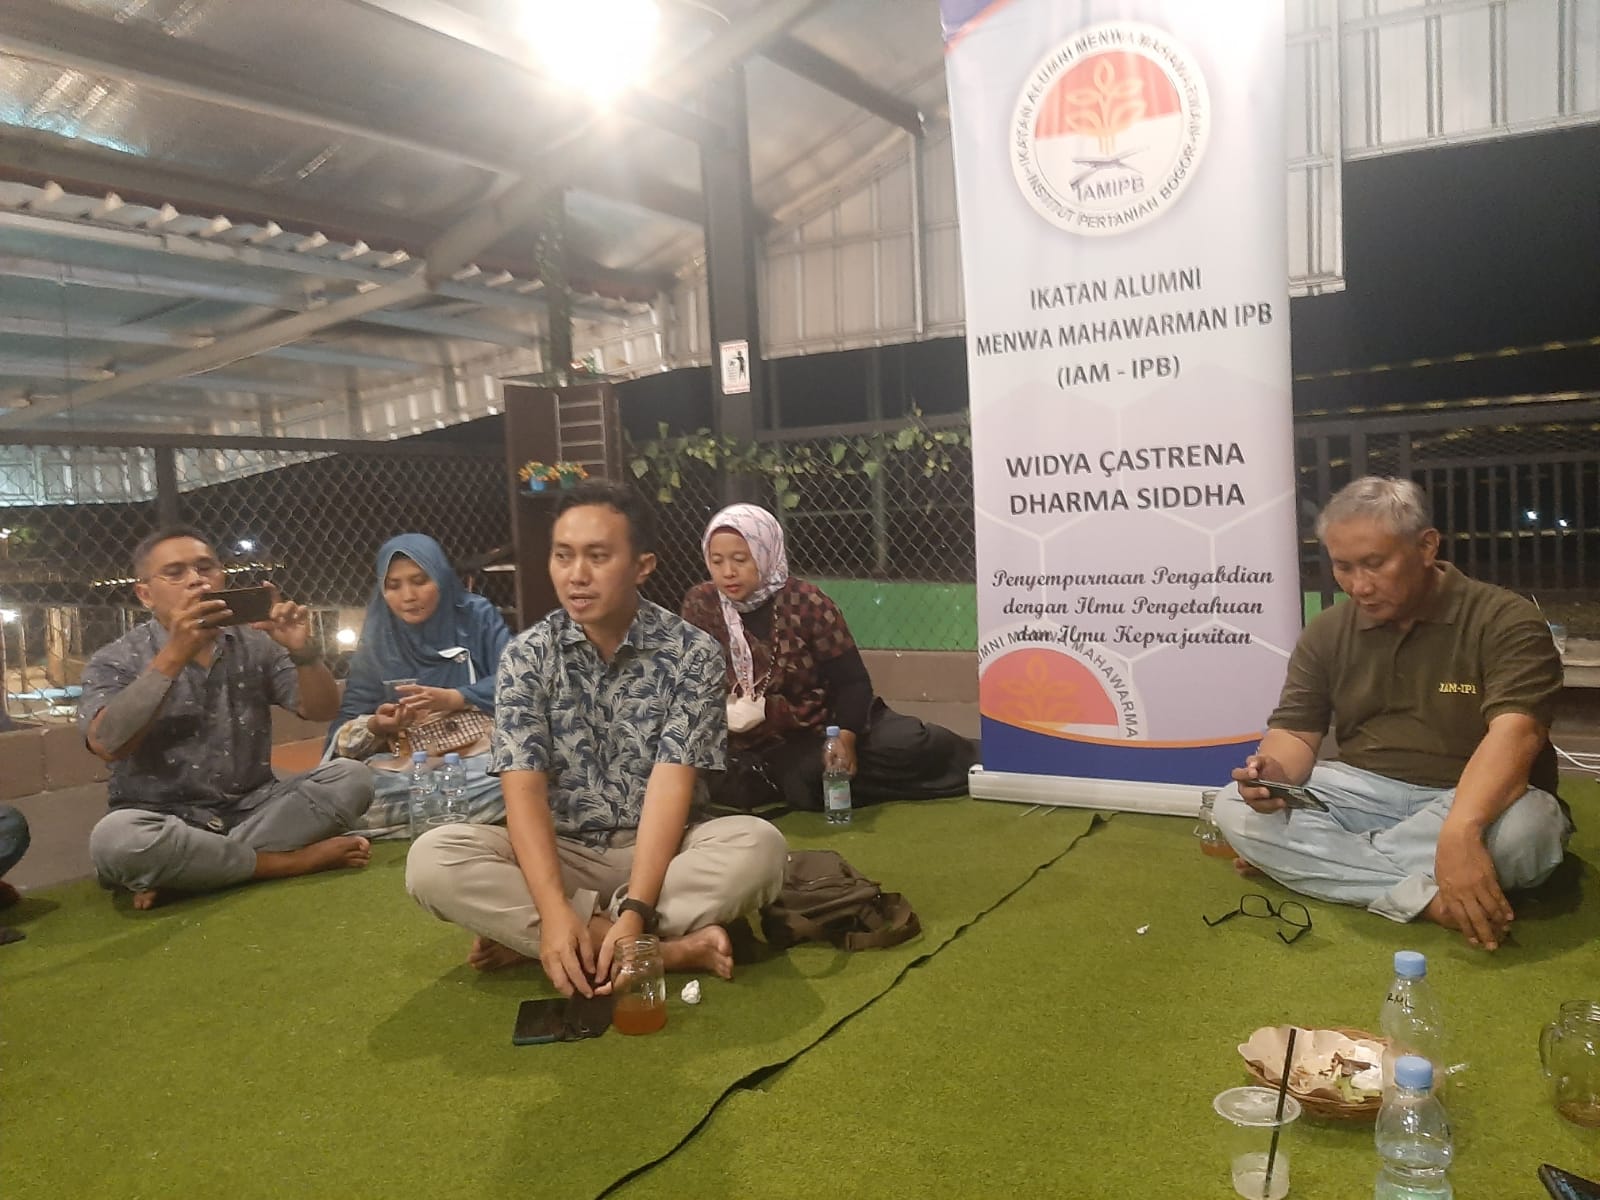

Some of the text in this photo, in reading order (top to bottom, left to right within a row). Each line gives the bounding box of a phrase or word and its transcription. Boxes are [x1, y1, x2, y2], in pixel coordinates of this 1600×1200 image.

[1077, 196, 1160, 229] PERTANIAN
[1030, 266, 1203, 311] IKATAN ALUMNI
[976, 302, 1273, 357] MENWA MAHAWARMAN IPB
[1057, 363, 1111, 389] (IAM
[1132, 355, 1181, 380] IPB)
[1005, 442, 1245, 478] WIDYA ÇASTRENA
[1010, 483, 1245, 515] DHARMA SIDDHA
[992, 565, 1274, 591] Penyempurnaan Pengabdian
[1003, 596, 1264, 620] dengan Ilmu Pengetahuan
[1057, 625, 1107, 643] Ilmu
[1113, 626, 1253, 649] Keprajuritan
